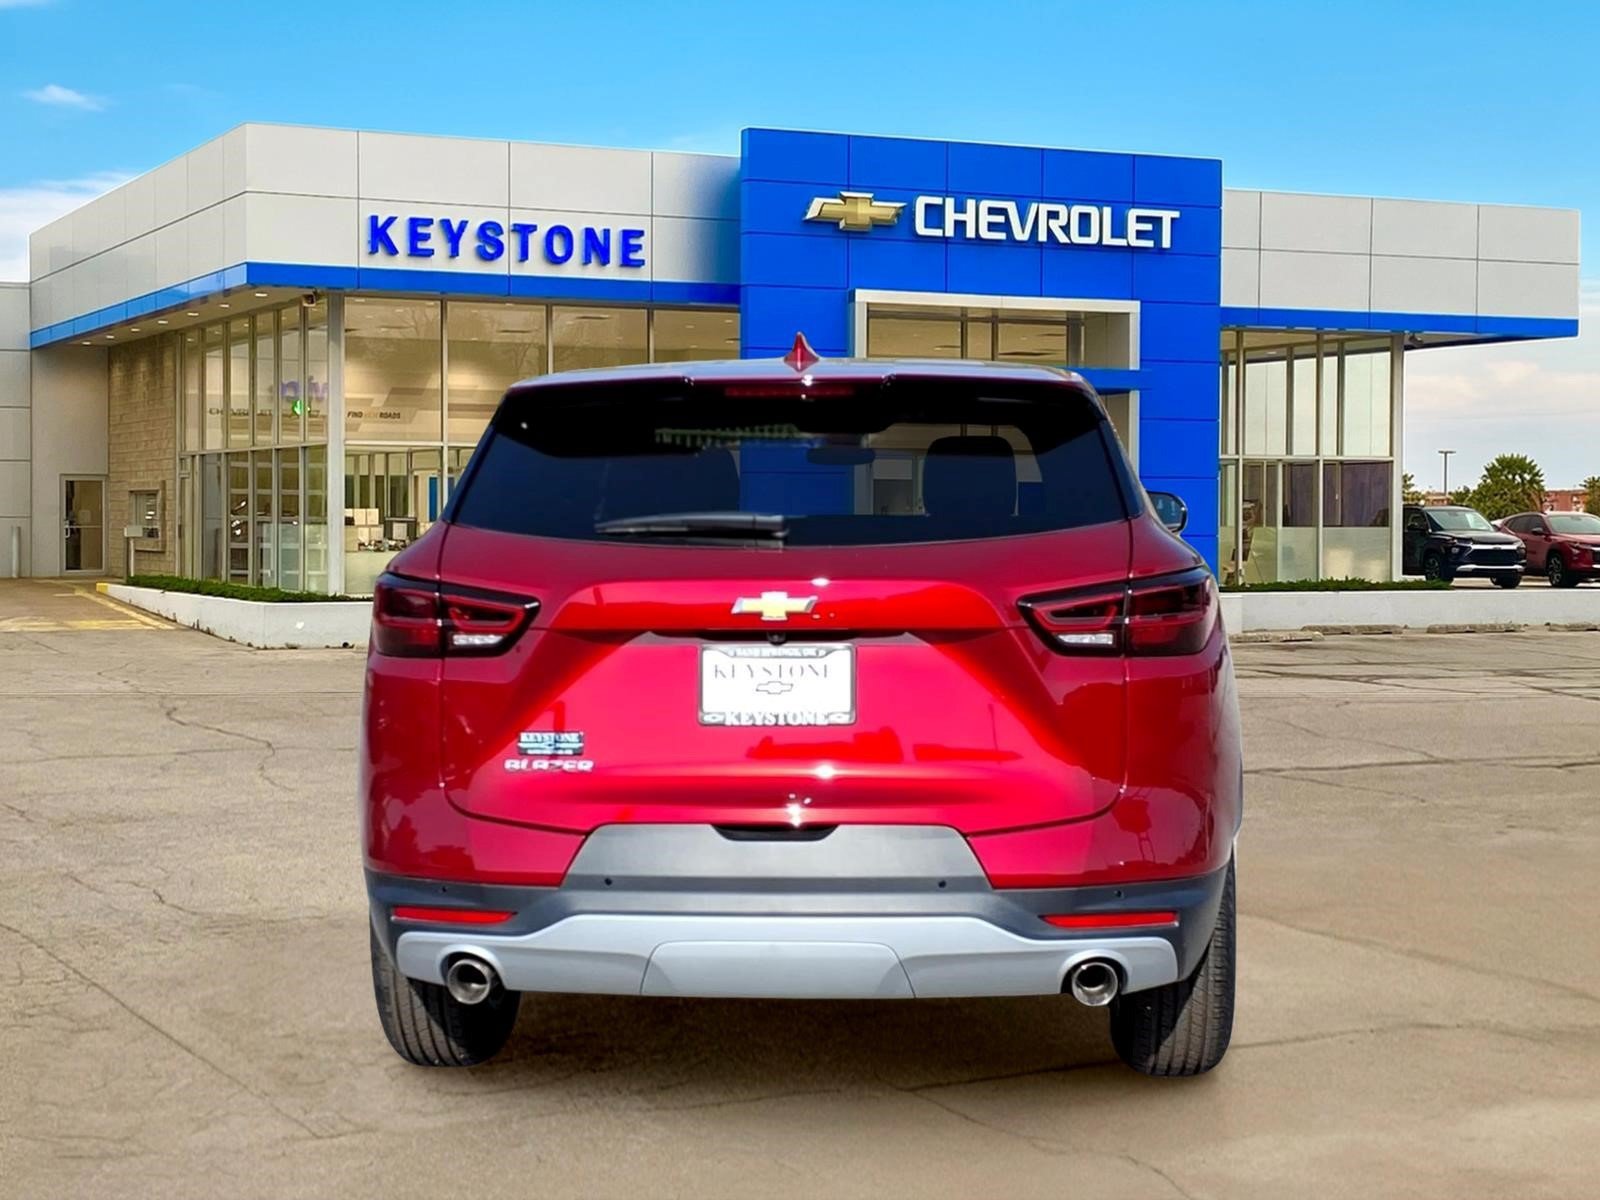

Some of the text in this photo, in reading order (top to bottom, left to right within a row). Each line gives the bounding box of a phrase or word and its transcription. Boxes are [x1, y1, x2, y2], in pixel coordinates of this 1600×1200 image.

[368, 214, 646, 268] KEYSTONE
[914, 195, 1181, 249] CHEVROLET
[724, 711, 829, 726] KEYSTONE
